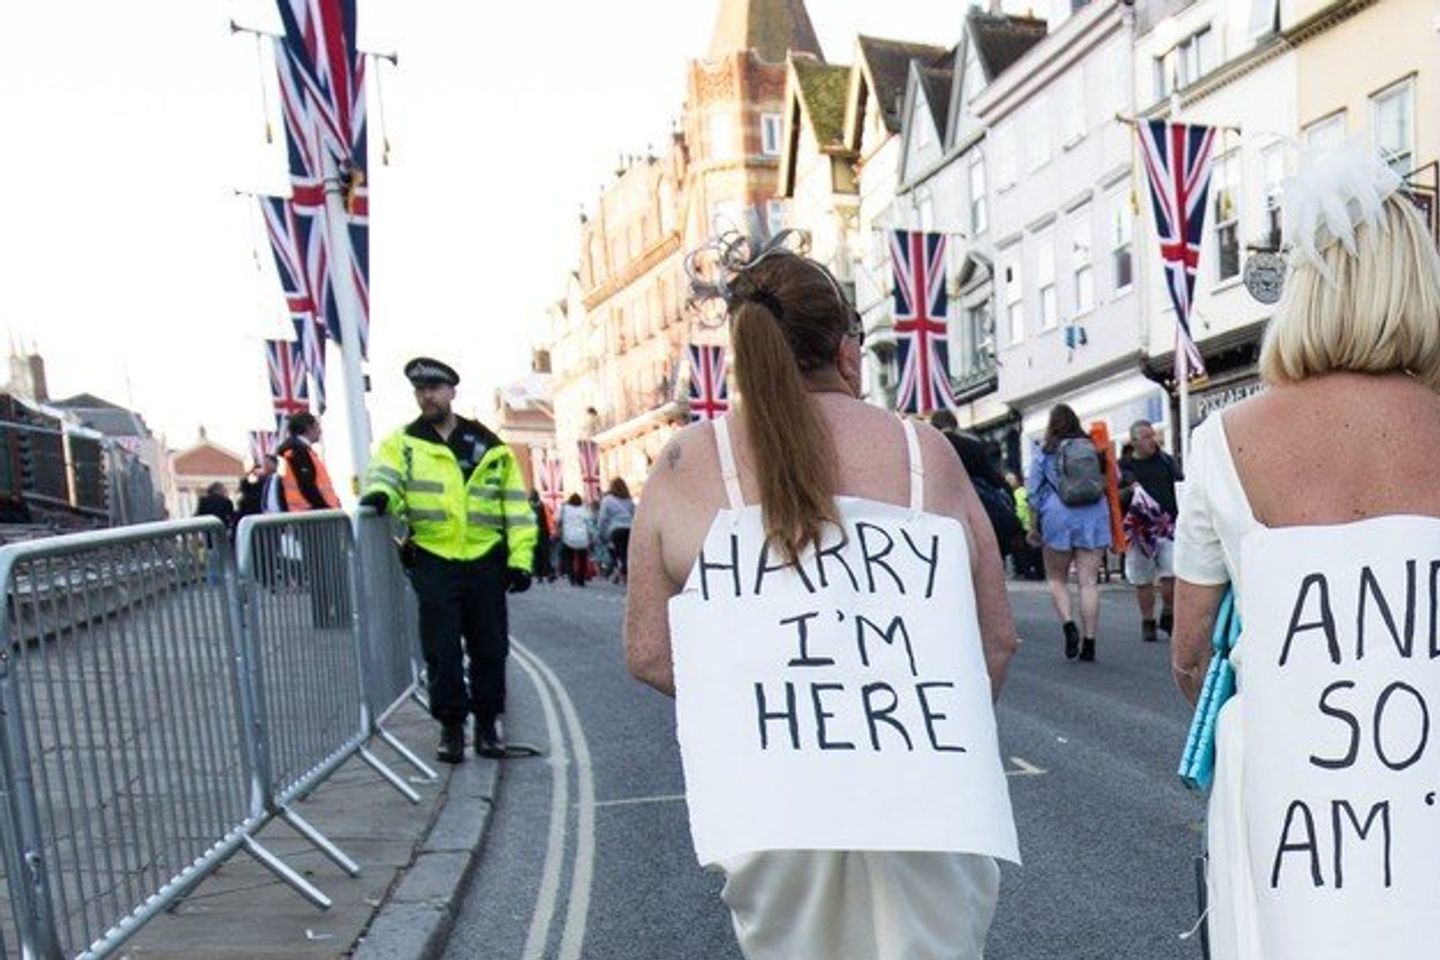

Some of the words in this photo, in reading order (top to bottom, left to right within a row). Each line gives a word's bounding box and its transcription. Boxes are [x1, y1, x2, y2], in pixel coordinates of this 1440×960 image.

[700, 522, 938, 600] HARRY
[779, 611, 918, 677] I'M
[755, 682, 966, 753] HERE
[1309, 680, 1430, 771] SO
[1271, 800, 1392, 889] AM
